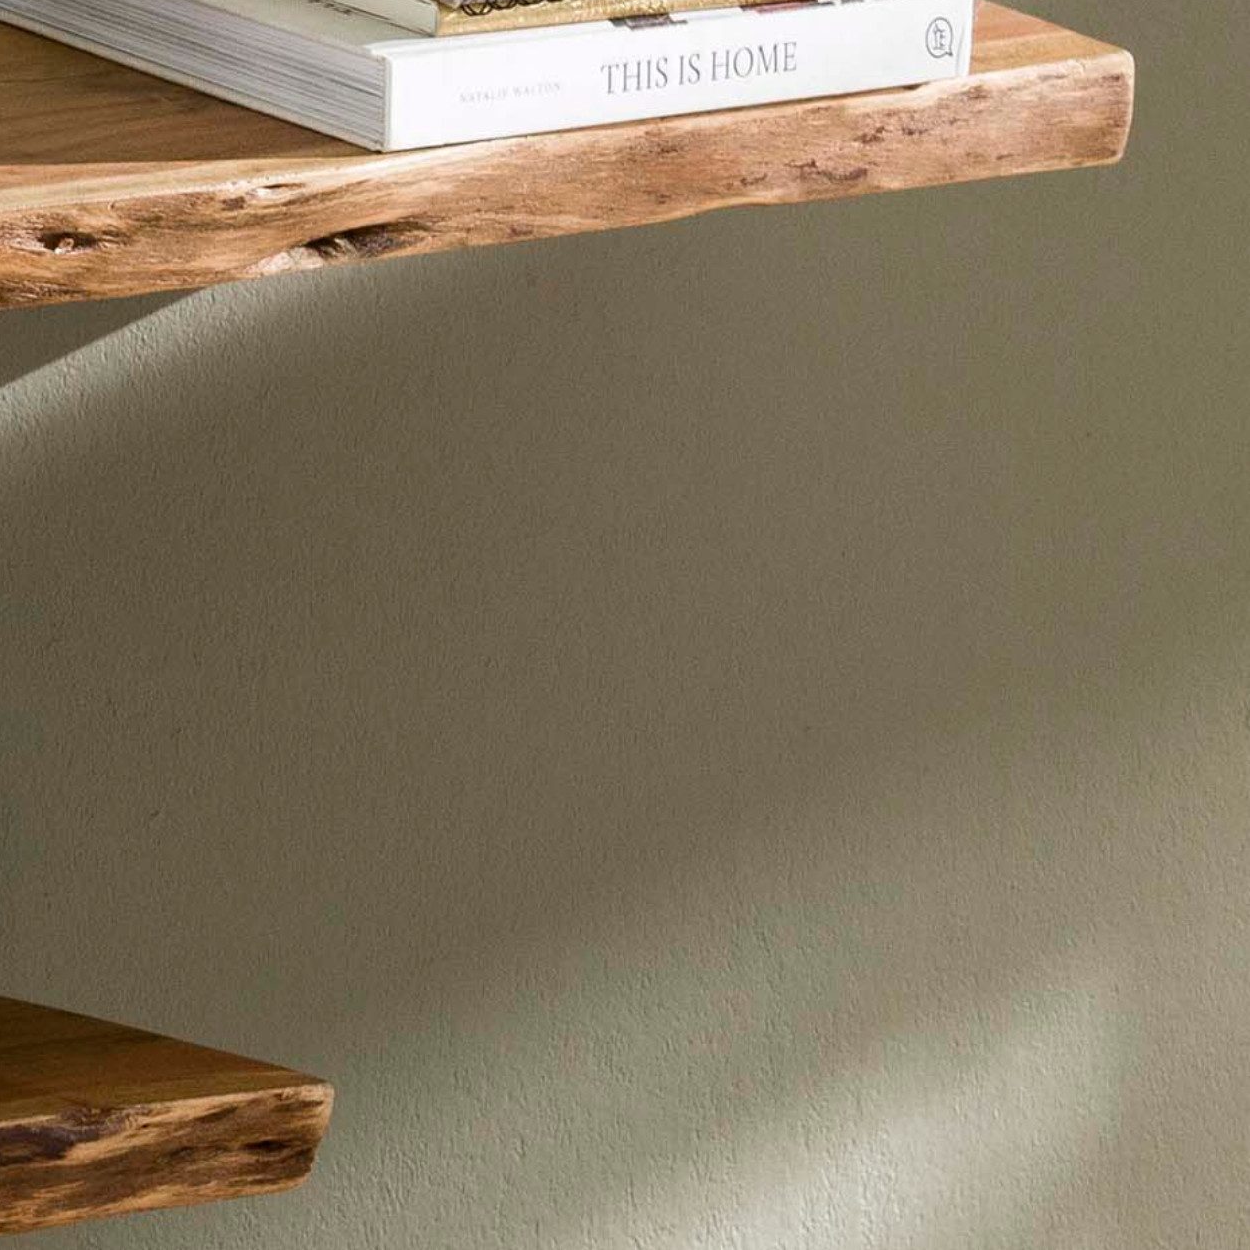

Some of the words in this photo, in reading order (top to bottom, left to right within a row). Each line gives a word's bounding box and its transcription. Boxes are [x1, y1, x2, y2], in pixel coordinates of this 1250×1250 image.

[601, 57, 668, 94] THIS
[678, 53, 700, 85] IS
[711, 41, 797, 81] HOME
